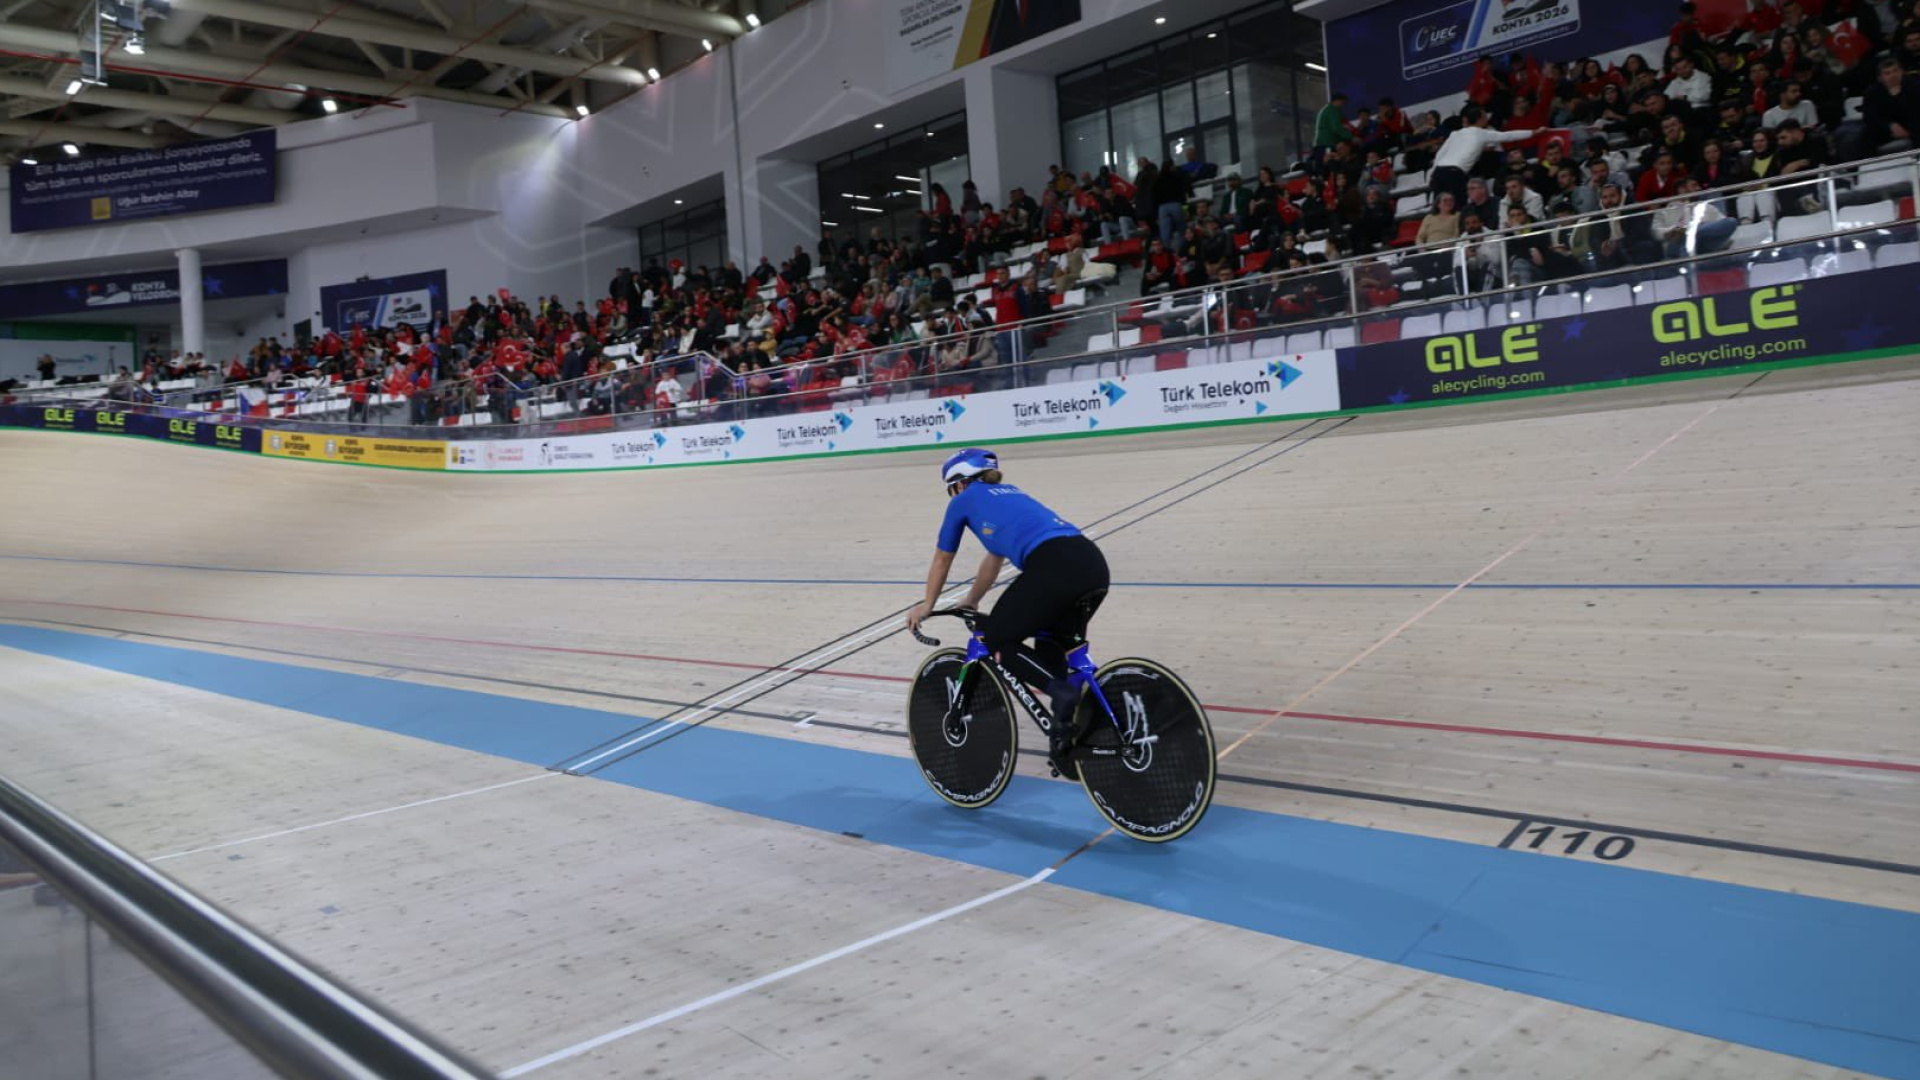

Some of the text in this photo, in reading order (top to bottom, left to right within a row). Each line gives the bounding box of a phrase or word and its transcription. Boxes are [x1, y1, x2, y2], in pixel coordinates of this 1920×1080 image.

[1492, 5, 1570, 35] KONYA 2026
[1430, 25, 1458, 42] UEC
[82, 174, 96, 184] ve
[131, 281, 166, 292] KONYA
[1659, 338, 1806, 367] alecycling.com
[1160, 379, 1272, 403] Türk Telekom
[1432, 371, 1545, 394] alecycling.com
[1013, 397, 1102, 417] Türk Telekom
[874, 412, 946, 431] Türk Telekom
[682, 434, 732, 449] Türk Telekom
[777, 424, 837, 441] Türk Telekom
[611, 441, 655, 454] Türk Telekom
[989, 656, 1051, 730] NARELLO
[1093, 781, 1204, 834] CAMPAGNOLO
[1526, 826, 1635, 860] 110
